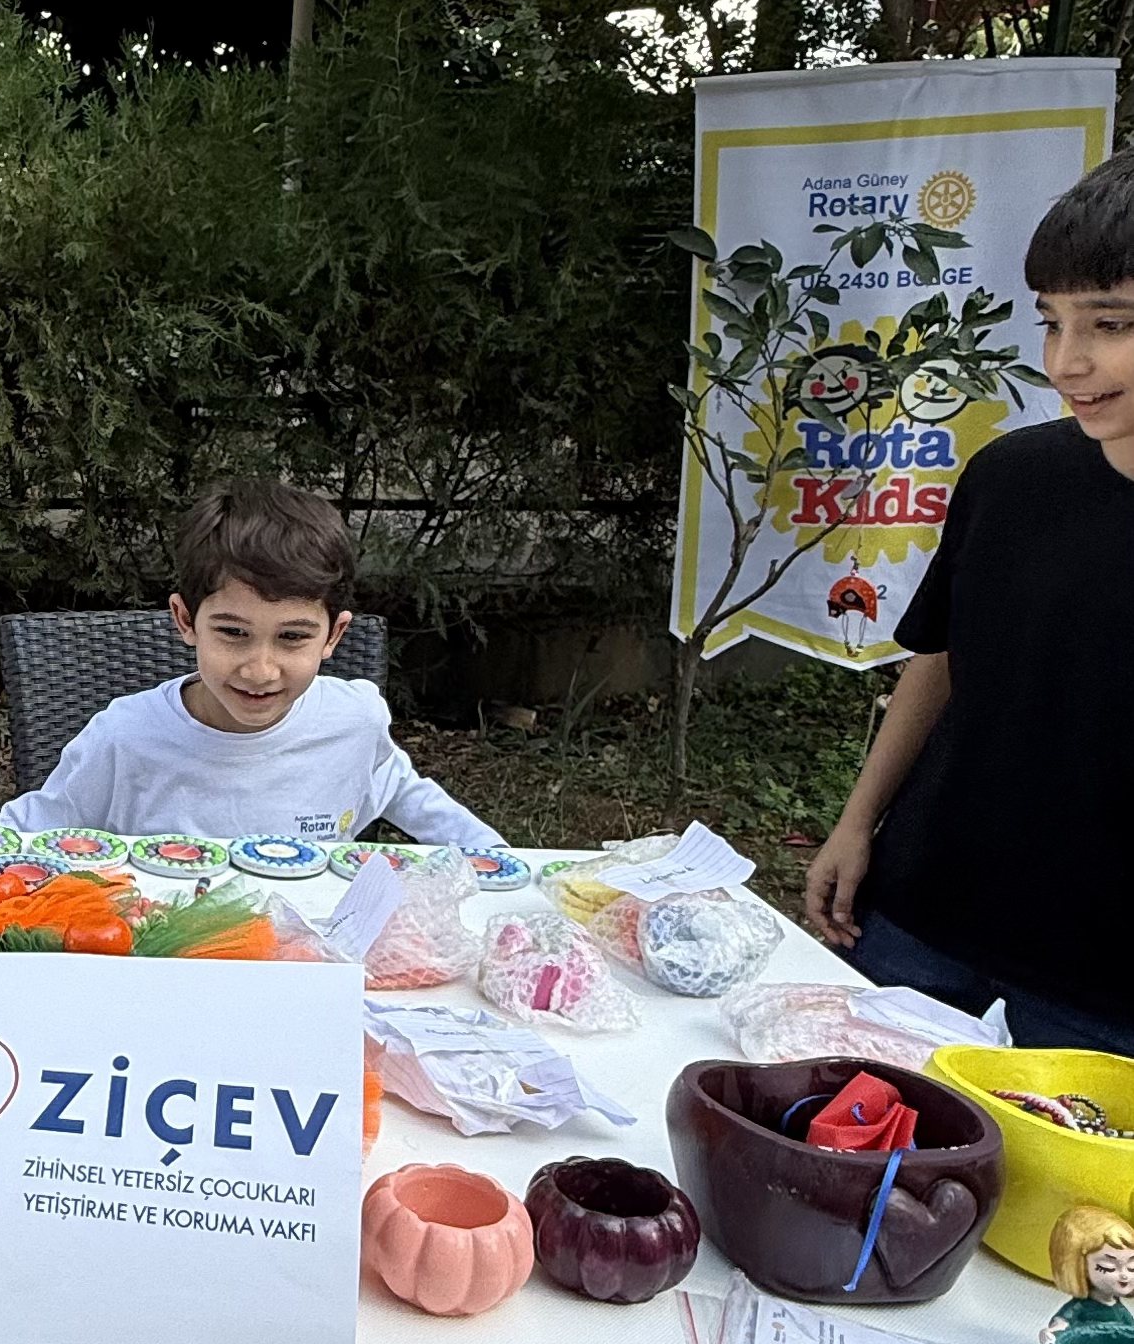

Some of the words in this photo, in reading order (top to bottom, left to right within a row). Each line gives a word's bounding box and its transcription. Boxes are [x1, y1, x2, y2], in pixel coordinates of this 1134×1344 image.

[802, 176, 852, 191] Adana
[857, 173, 909, 189] Güney
[809, 192, 909, 219] Rotary
[838, 271, 889, 290] 2430
[797, 422, 955, 470] Rota
[300, 821, 336, 833] Rotary
[29, 1054, 340, 1167] ZİÇEV
[22, 1157, 107, 1187] ZİHİNSEL
[111, 1167, 195, 1195] YETERSİZ
[199, 1177, 316, 1208] ÇOCUKLARI
[23, 1191, 127, 1222] YETİŞTİRME
[132, 1204, 160, 1225] VE
[163, 1207, 255, 1237] KORUMA
[259, 1219, 316, 1243] VAKFI
